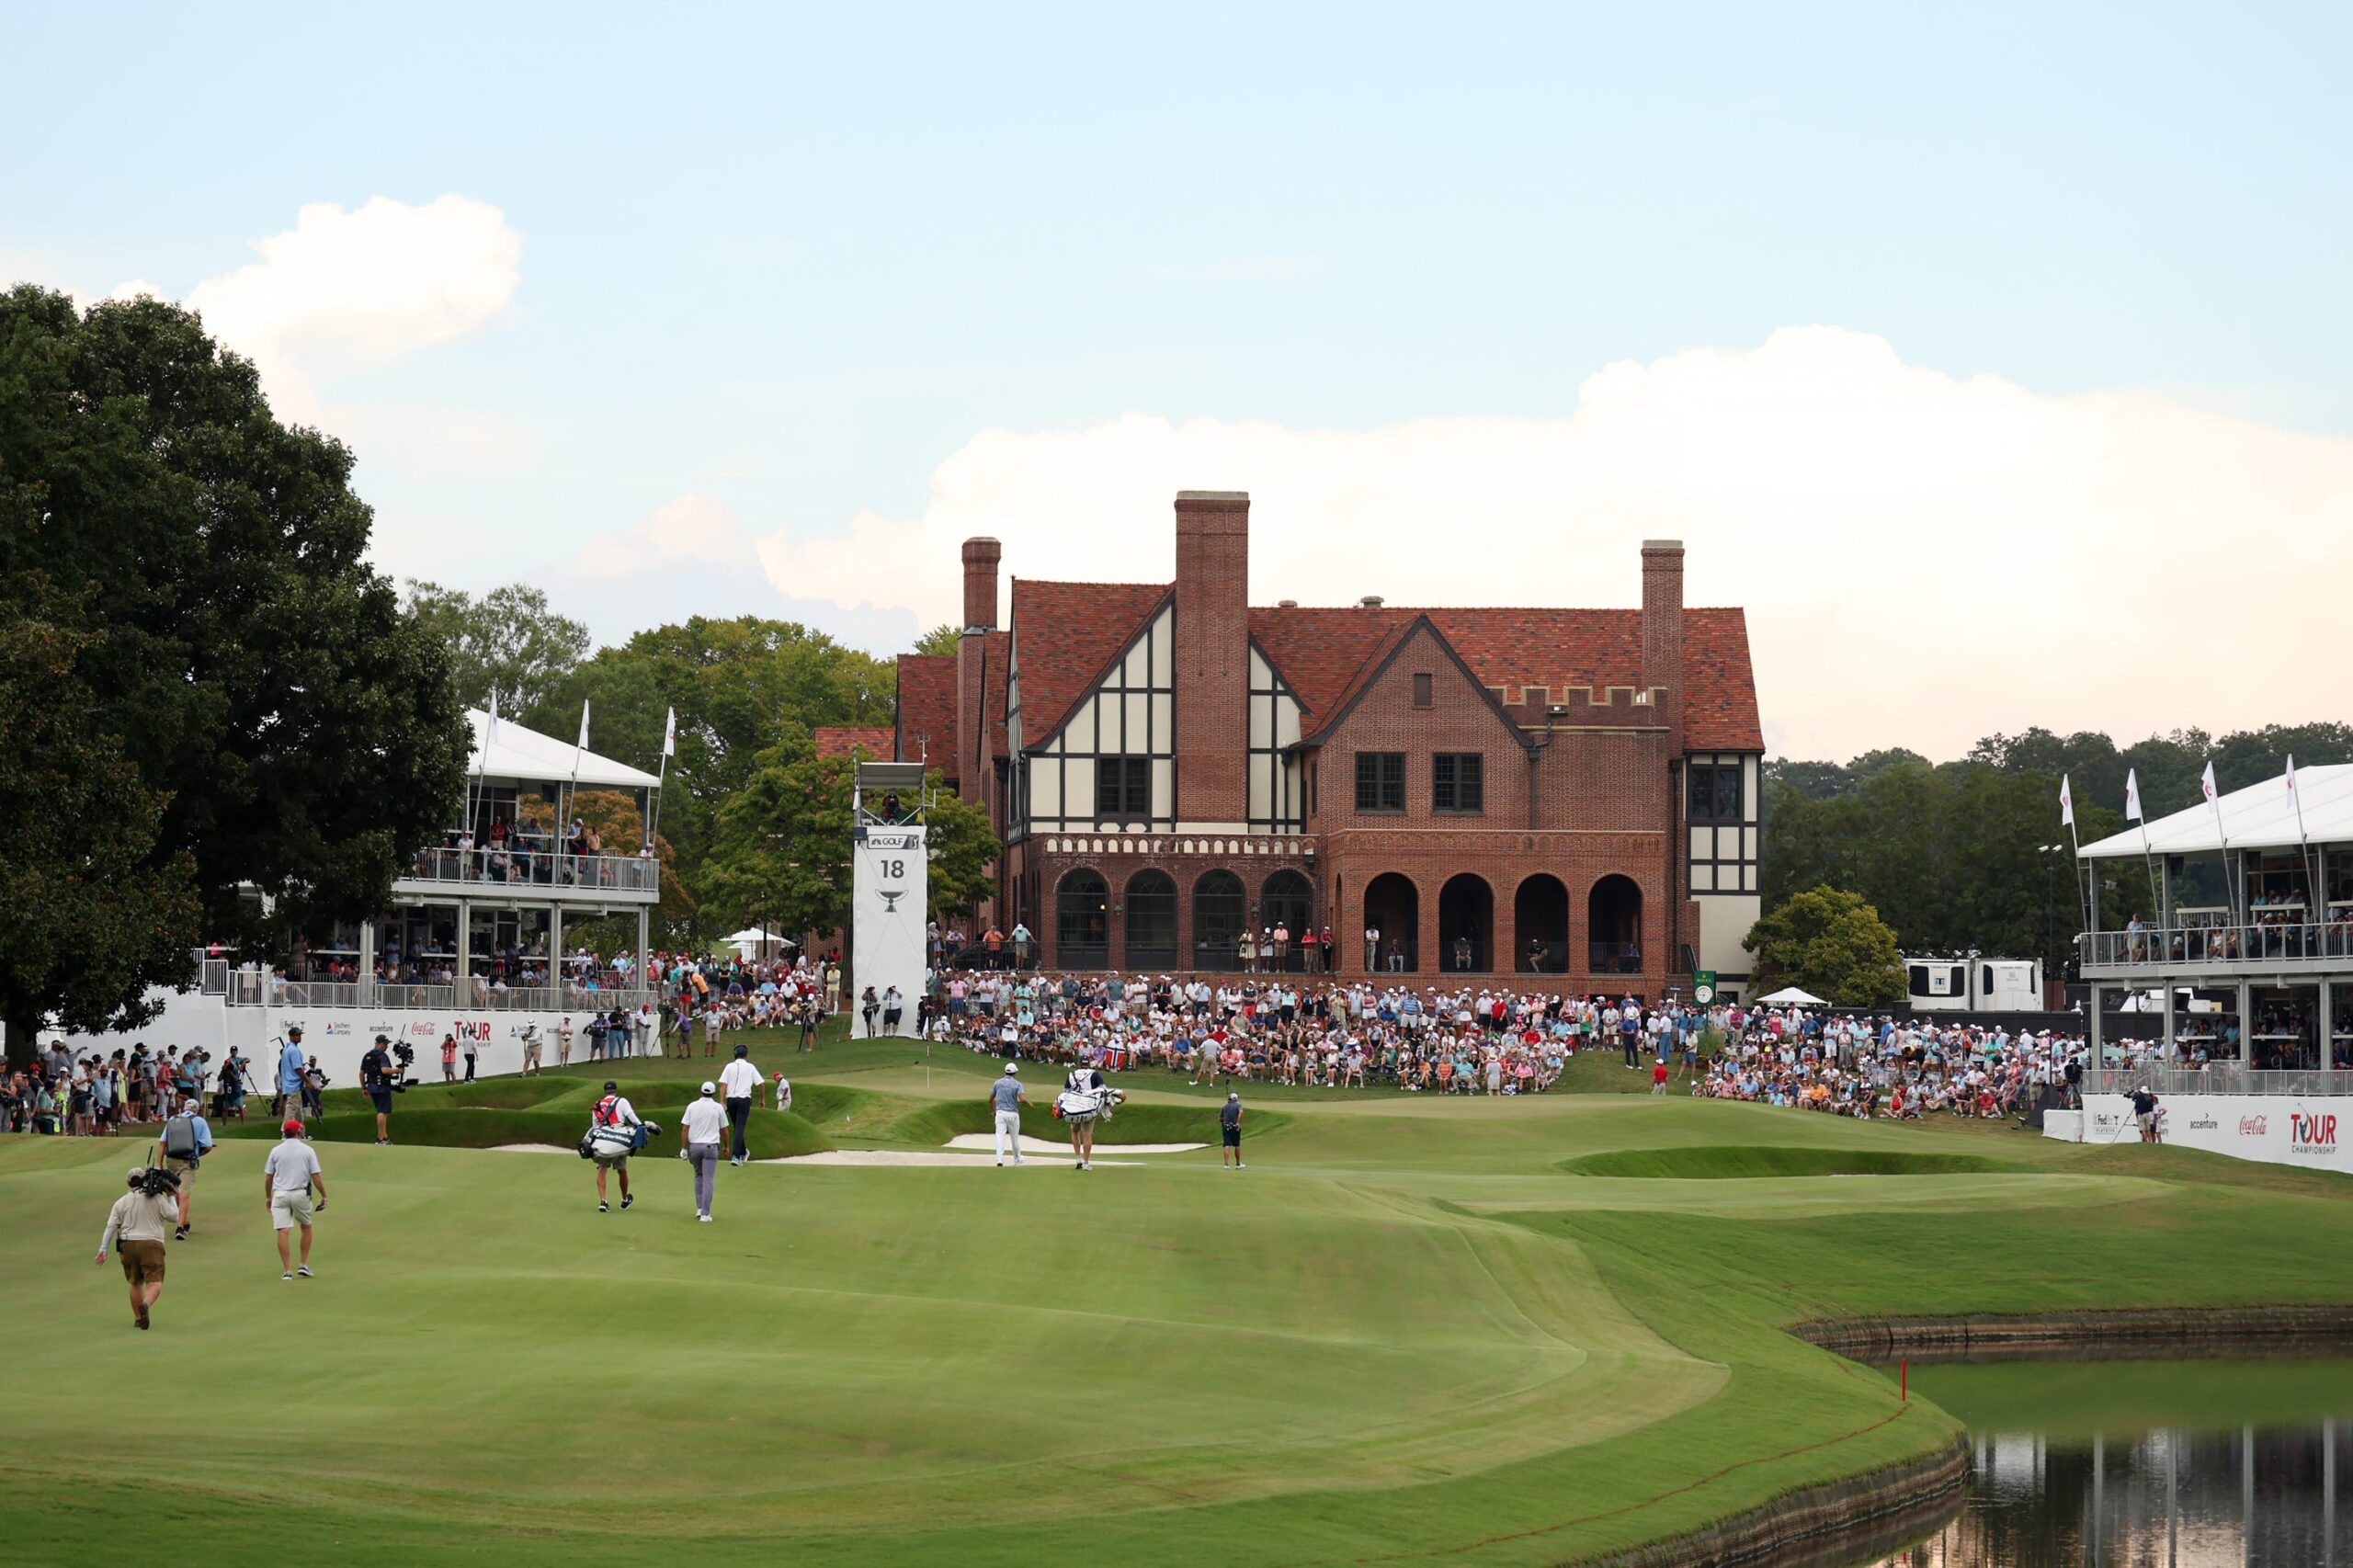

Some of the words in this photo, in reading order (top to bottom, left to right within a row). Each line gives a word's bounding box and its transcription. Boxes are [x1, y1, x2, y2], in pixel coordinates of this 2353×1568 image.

[881, 837, 904, 846] GOLF
[881, 859, 904, 879] 18
[2189, 1119, 2218, 1130] accenture
[2290, 1113, 2336, 1145] TOUR
[2291, 1145, 2336, 1155] CHAMPIONSHIP
